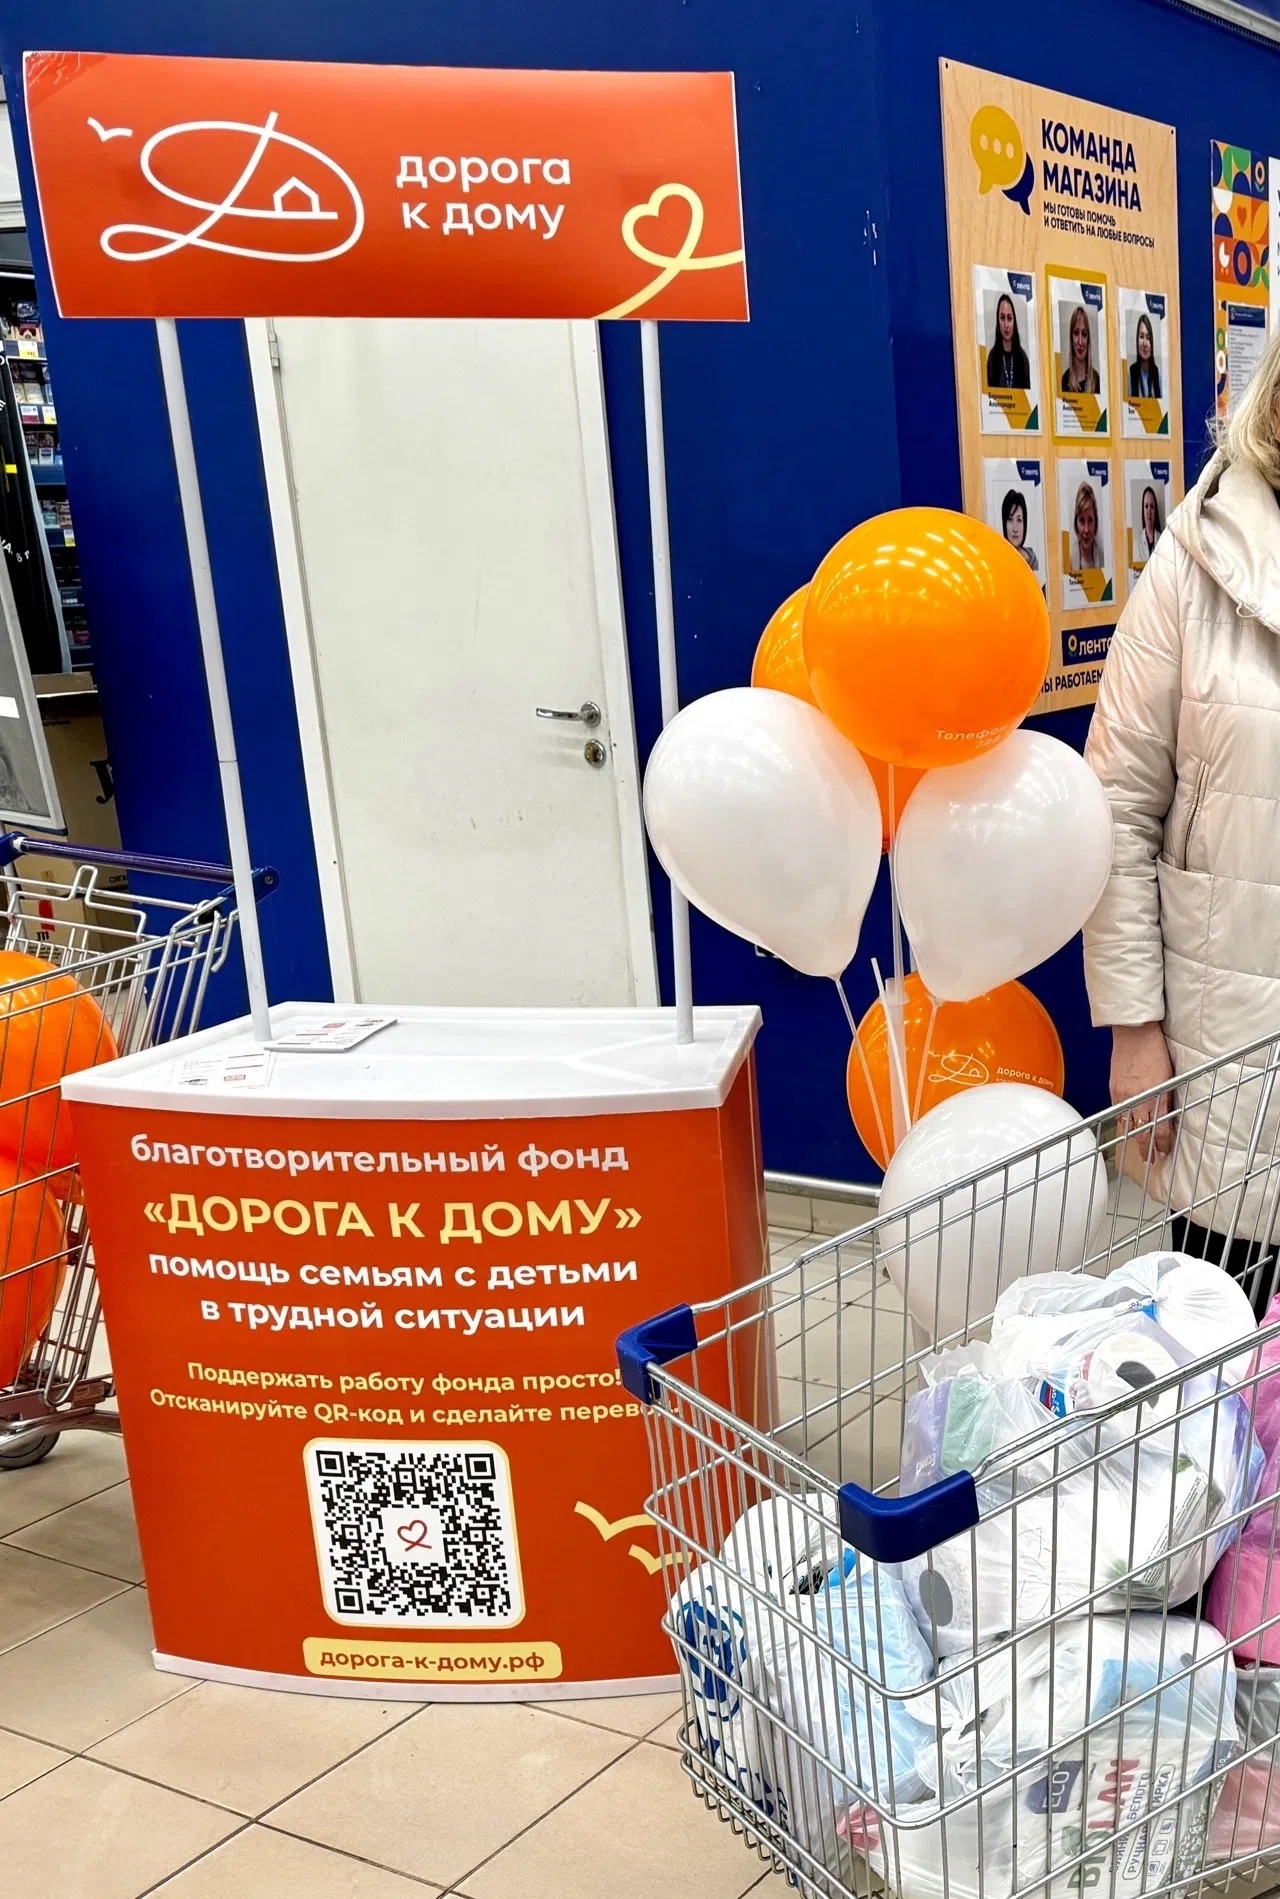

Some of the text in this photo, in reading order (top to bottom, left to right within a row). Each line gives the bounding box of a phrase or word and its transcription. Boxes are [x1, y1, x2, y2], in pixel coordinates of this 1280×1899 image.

[1041, 118, 1137, 175] КОМАНДА
[396, 155, 572, 194] дорога
[1042, 160, 1142, 212] МАГАЗИНА
[402, 203, 567, 240] к дому
[1043, 201, 1116, 227] МЫ ГОТОВЫ ПОМОЧЬ
[1044, 215, 1155, 248] И ОТВЕТИТЬ НА ЛЮБЫЕ ВОПРОСЫ
[996, 1066, 1030, 1081] дорога
[131, 1133, 630, 1178] благотворительный фонд
[143, 1192, 644, 1246] «ДОРОГА К ДОМУ»
[148, 1253, 639, 1292] помощь семьям с детьми
[200, 1300, 586, 1337] в трудной ситуации
[187, 1362, 622, 1398] Поддержать работу фонда просто!
[150, 1388, 309, 1422] Отсканируйте
[313, 1401, 405, 1426] QR-код
[409, 1409, 427, 1425] и
[432, 1403, 554, 1428] сделайте
[320, 1651, 545, 1673] дорога-к-дому.рф
[1042, 1770, 1070, 1809] ECO
[1126, 1772, 1151, 1821] БЕЛОГО
[1152, 1771, 1171, 1810] ТИРКА
